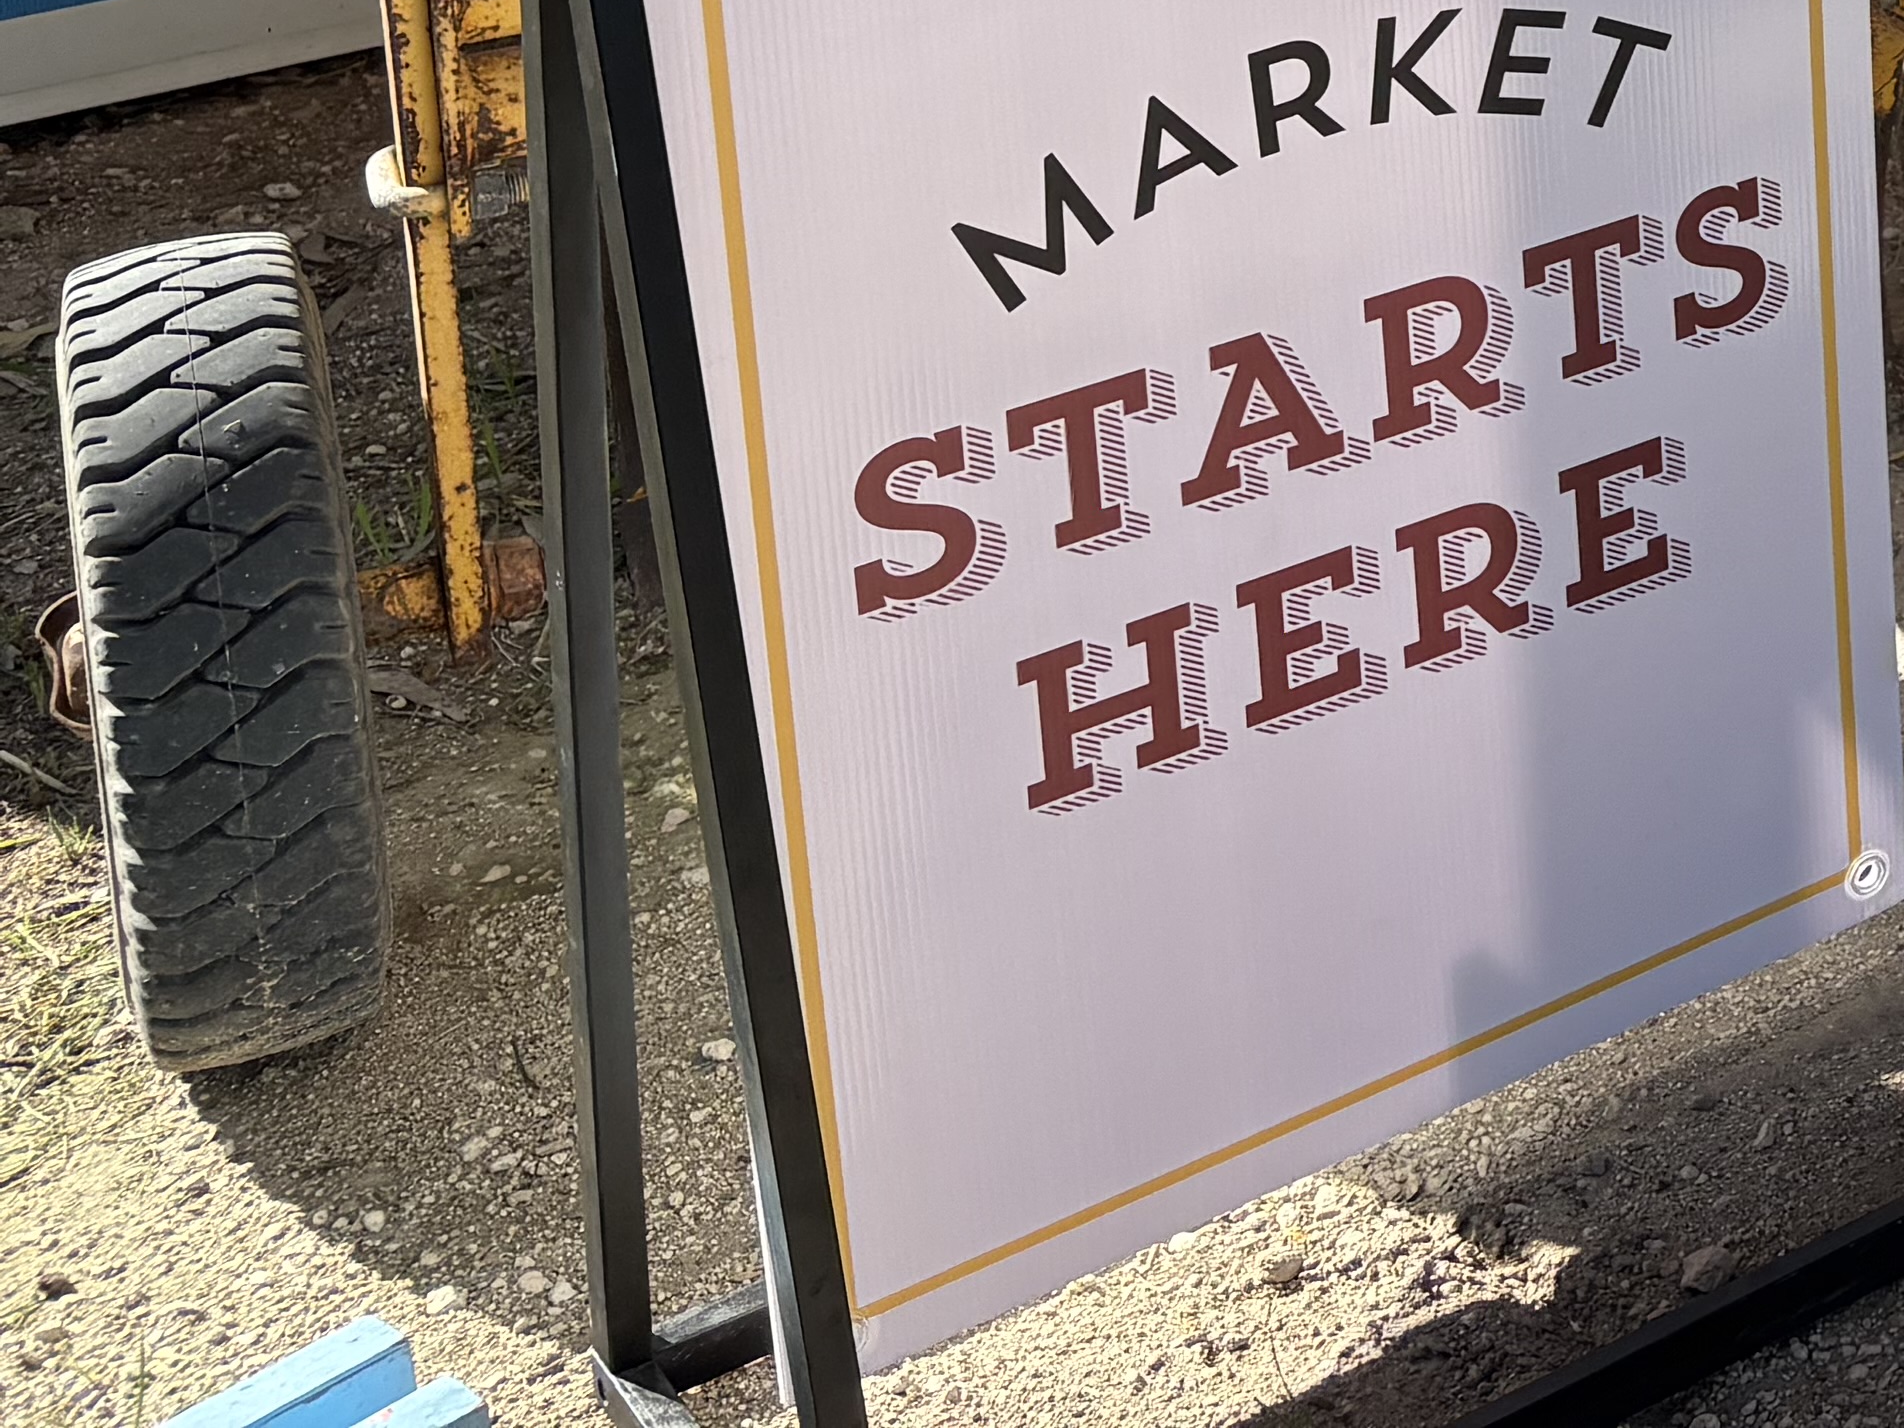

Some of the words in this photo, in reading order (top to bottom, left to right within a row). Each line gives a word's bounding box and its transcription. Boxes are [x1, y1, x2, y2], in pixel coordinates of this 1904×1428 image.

[951, 7, 1672, 312] MARKET
[853, 175, 1788, 622] STARTS
[1016, 436, 1692, 816] HERE
